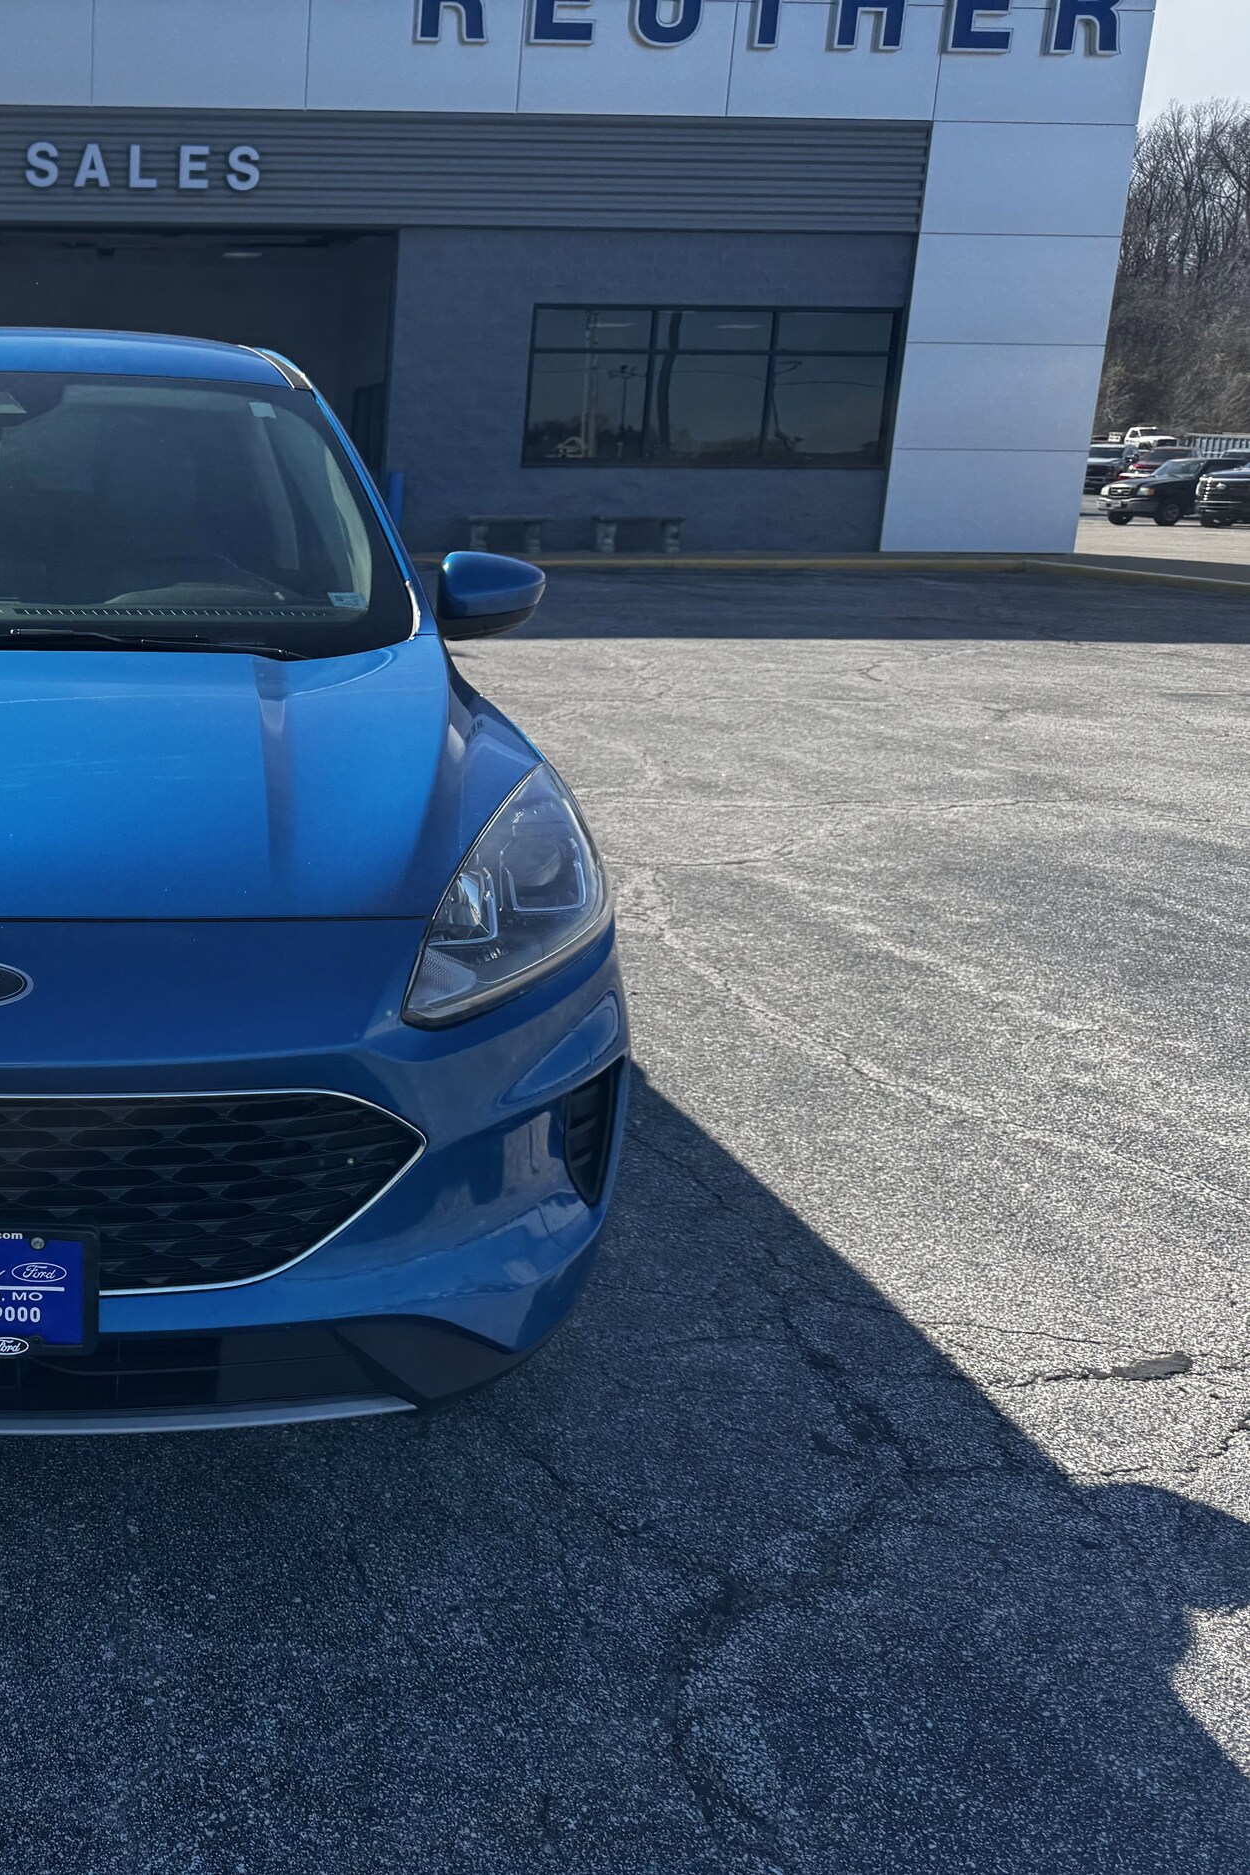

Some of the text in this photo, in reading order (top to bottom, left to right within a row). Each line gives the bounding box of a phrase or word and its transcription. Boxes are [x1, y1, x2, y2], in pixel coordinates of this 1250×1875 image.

[25, 141, 260, 191] SALES
[22, 1264, 56, 1280] Ford
[11, 1292, 43, 1301] MO
